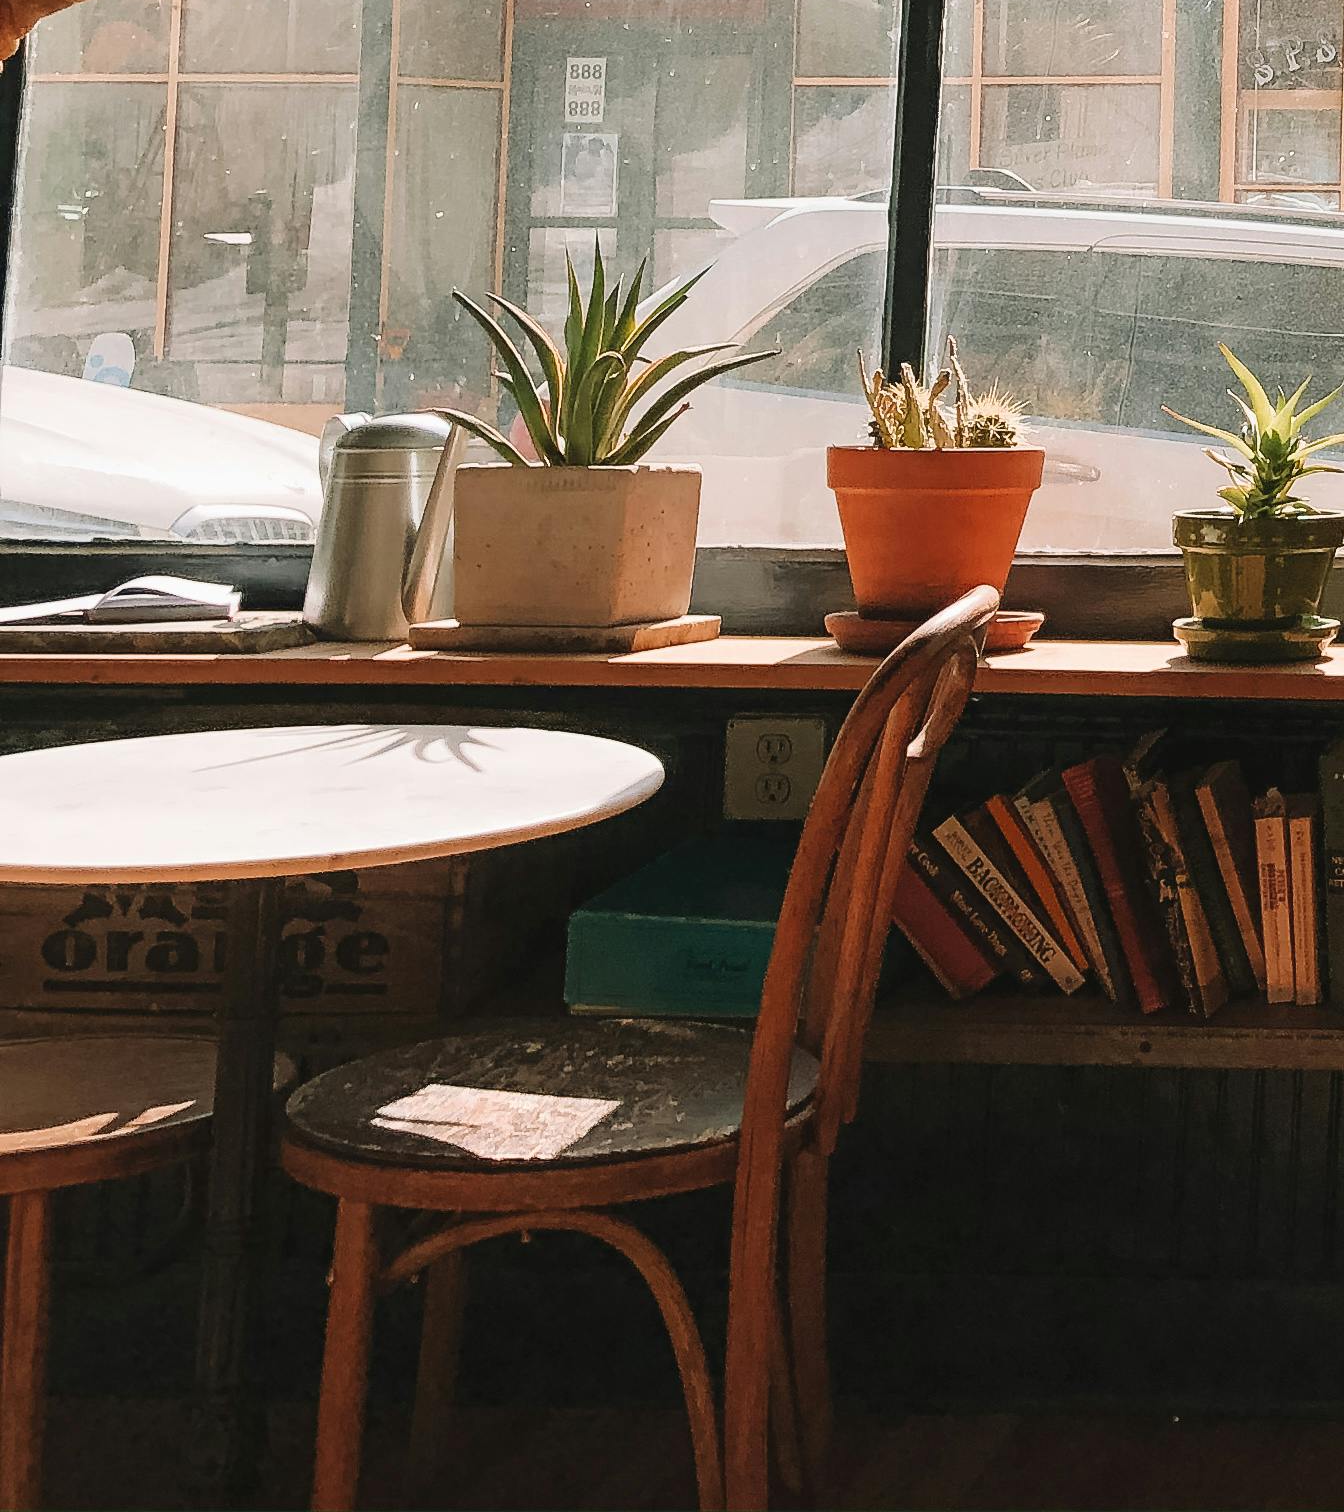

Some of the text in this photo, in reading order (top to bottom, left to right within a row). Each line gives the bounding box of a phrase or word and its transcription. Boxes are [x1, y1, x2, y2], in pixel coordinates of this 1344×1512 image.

[570, 63, 602, 79] 888
[966, 856, 1057, 965] BACKPACKING
[41, 927, 390, 999] orage
